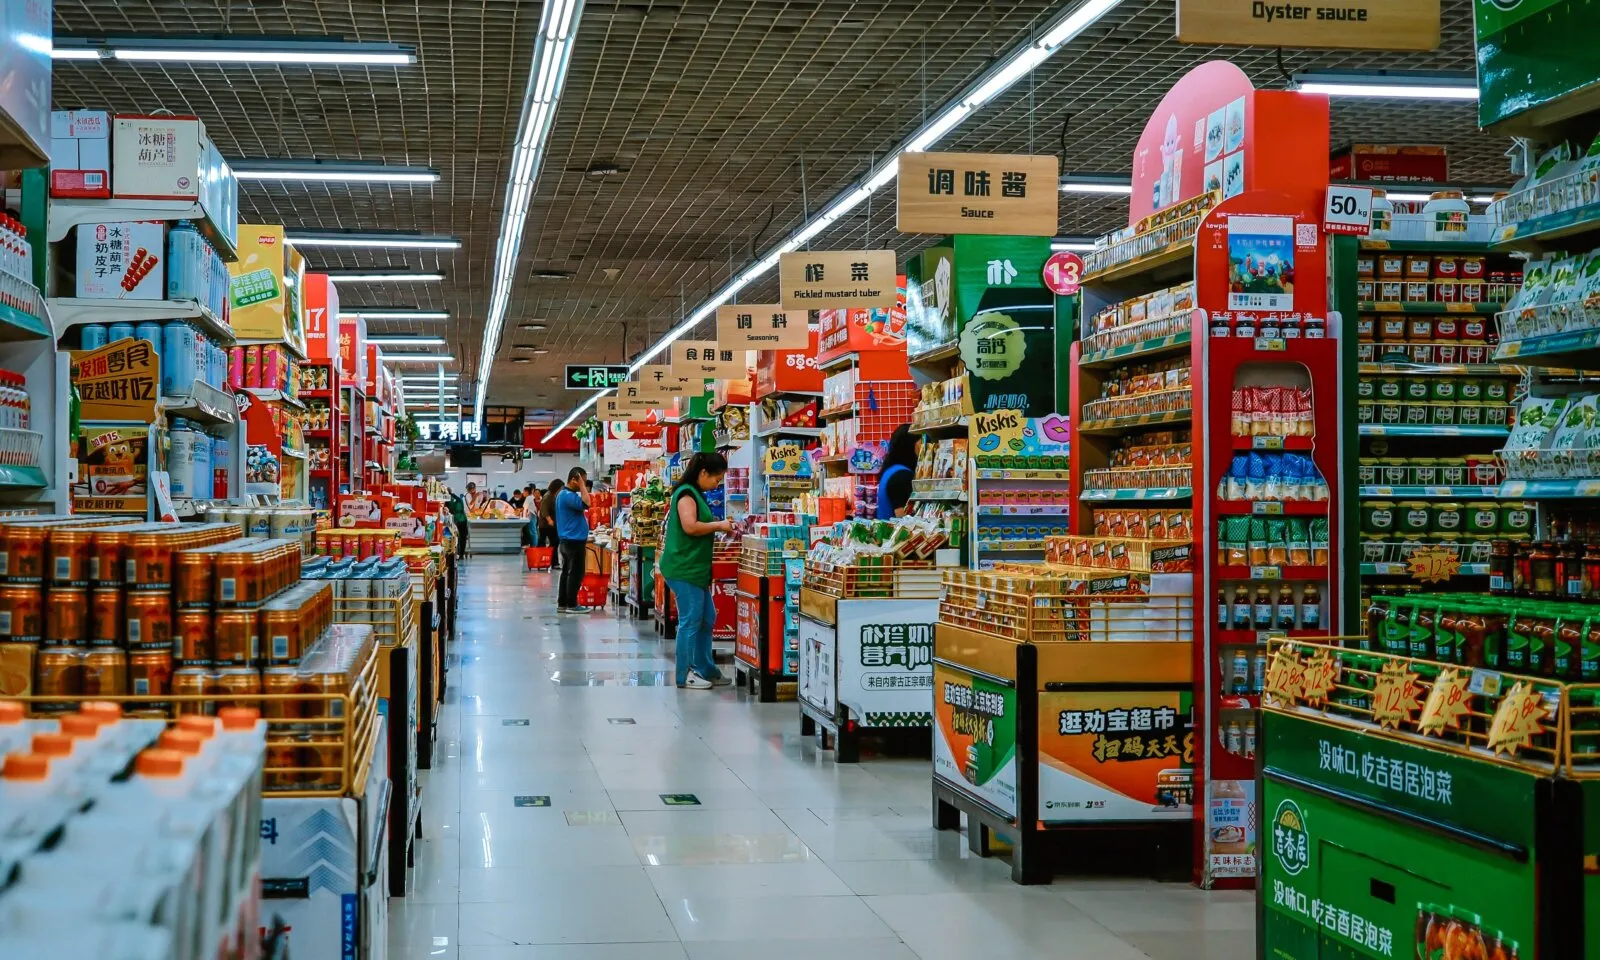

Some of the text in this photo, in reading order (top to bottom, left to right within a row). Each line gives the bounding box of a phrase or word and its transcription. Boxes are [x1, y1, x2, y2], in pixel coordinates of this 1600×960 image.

[1252, 1, 1368, 22] Oyster sauce
[138, 133, 165, 146] 冰糖
[138, 148, 165, 162] 葫芦
[928, 168, 1027, 198] 调味酱
[960, 206, 994, 219] Sauce
[1330, 195, 1368, 218] 50 kg
[109, 226, 123, 275] 冰糖葫芦
[94, 243, 108, 278] 奶皮子
[805, 262, 869, 283] 榨菜
[1048, 261, 1079, 285] 13
[794, 288, 881, 299] Pickled mustard tuber
[736, 313, 787, 330] 调料
[747, 334, 779, 342] Seasoning
[977, 337, 1006, 354] 高钙
[686, 348, 733, 362] 食用糖
[701, 365, 717, 373] Sugar
[77, 376, 156, 401] 吃越好吃
[627, 387, 637, 397] 方
[976, 413, 1018, 435] Kiskis
[770, 447, 797, 461] Kiskis
[861, 644, 933, 669] 营养加
[1060, 707, 1175, 734] 逛劝宝超市
[1274, 824, 1307, 863] 吉香居
[1213, 856, 1253, 866] 美味标志
